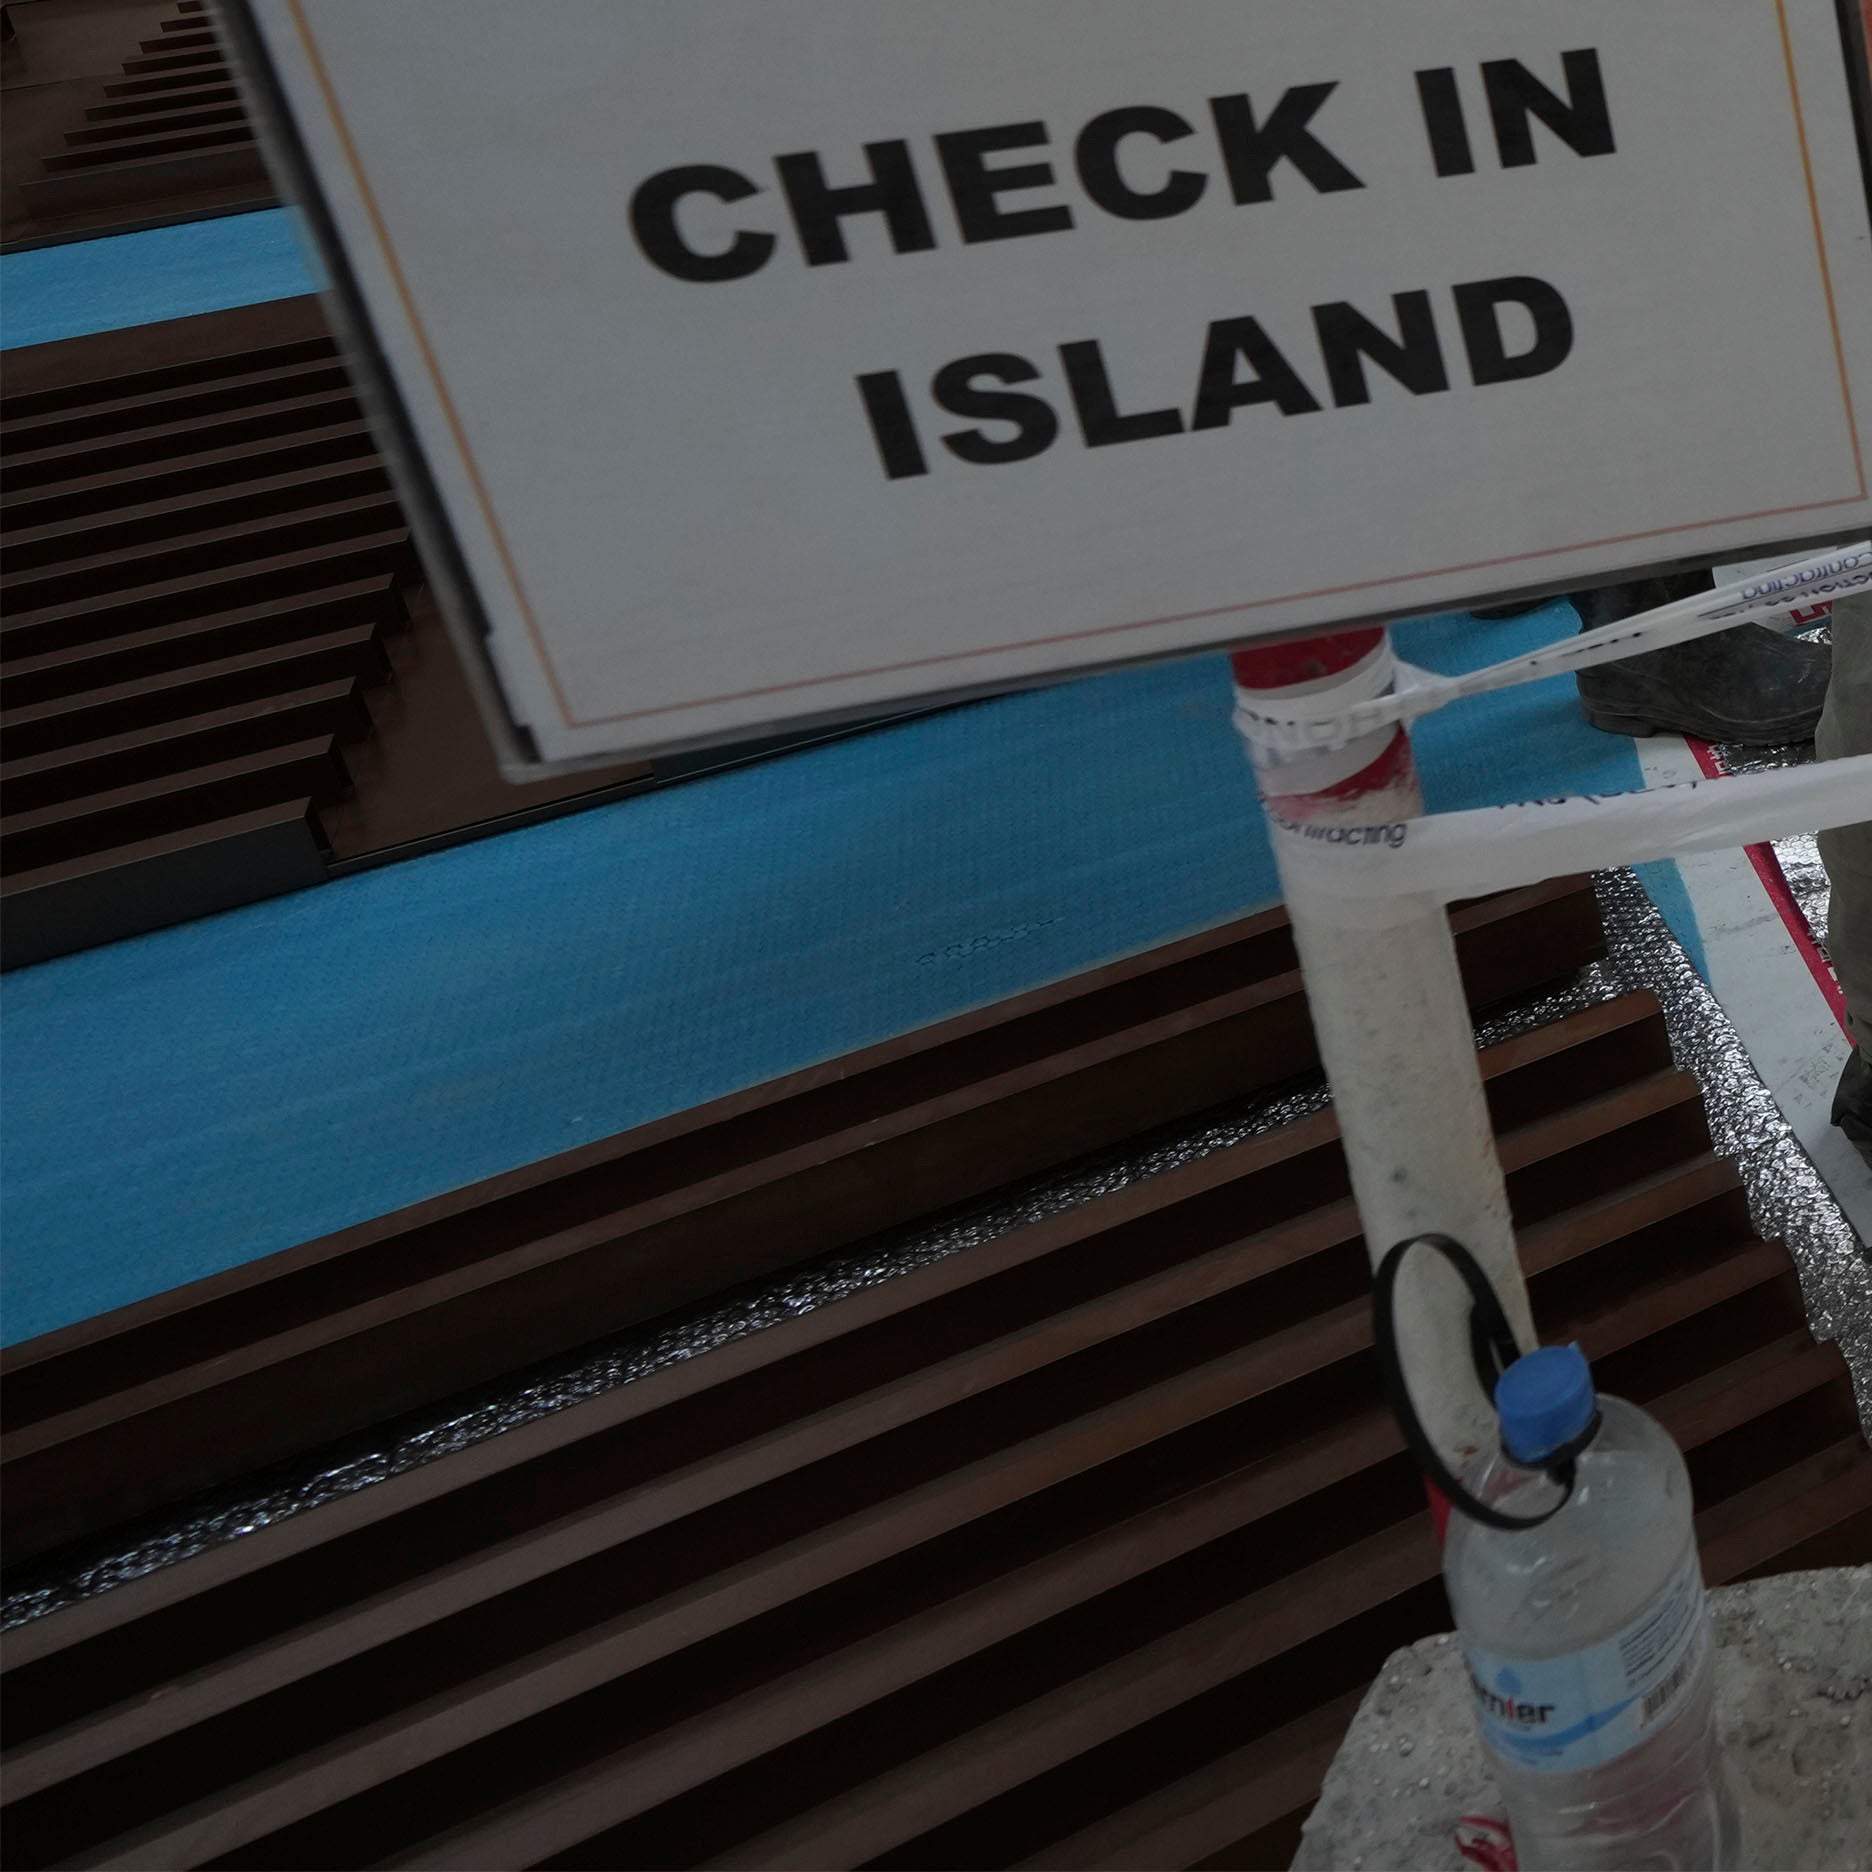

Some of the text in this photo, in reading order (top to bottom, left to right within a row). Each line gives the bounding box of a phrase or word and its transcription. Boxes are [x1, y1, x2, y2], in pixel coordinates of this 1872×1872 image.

[628, 45, 1620, 286] CHECK IN
[857, 275, 1578, 481] ISLAND
